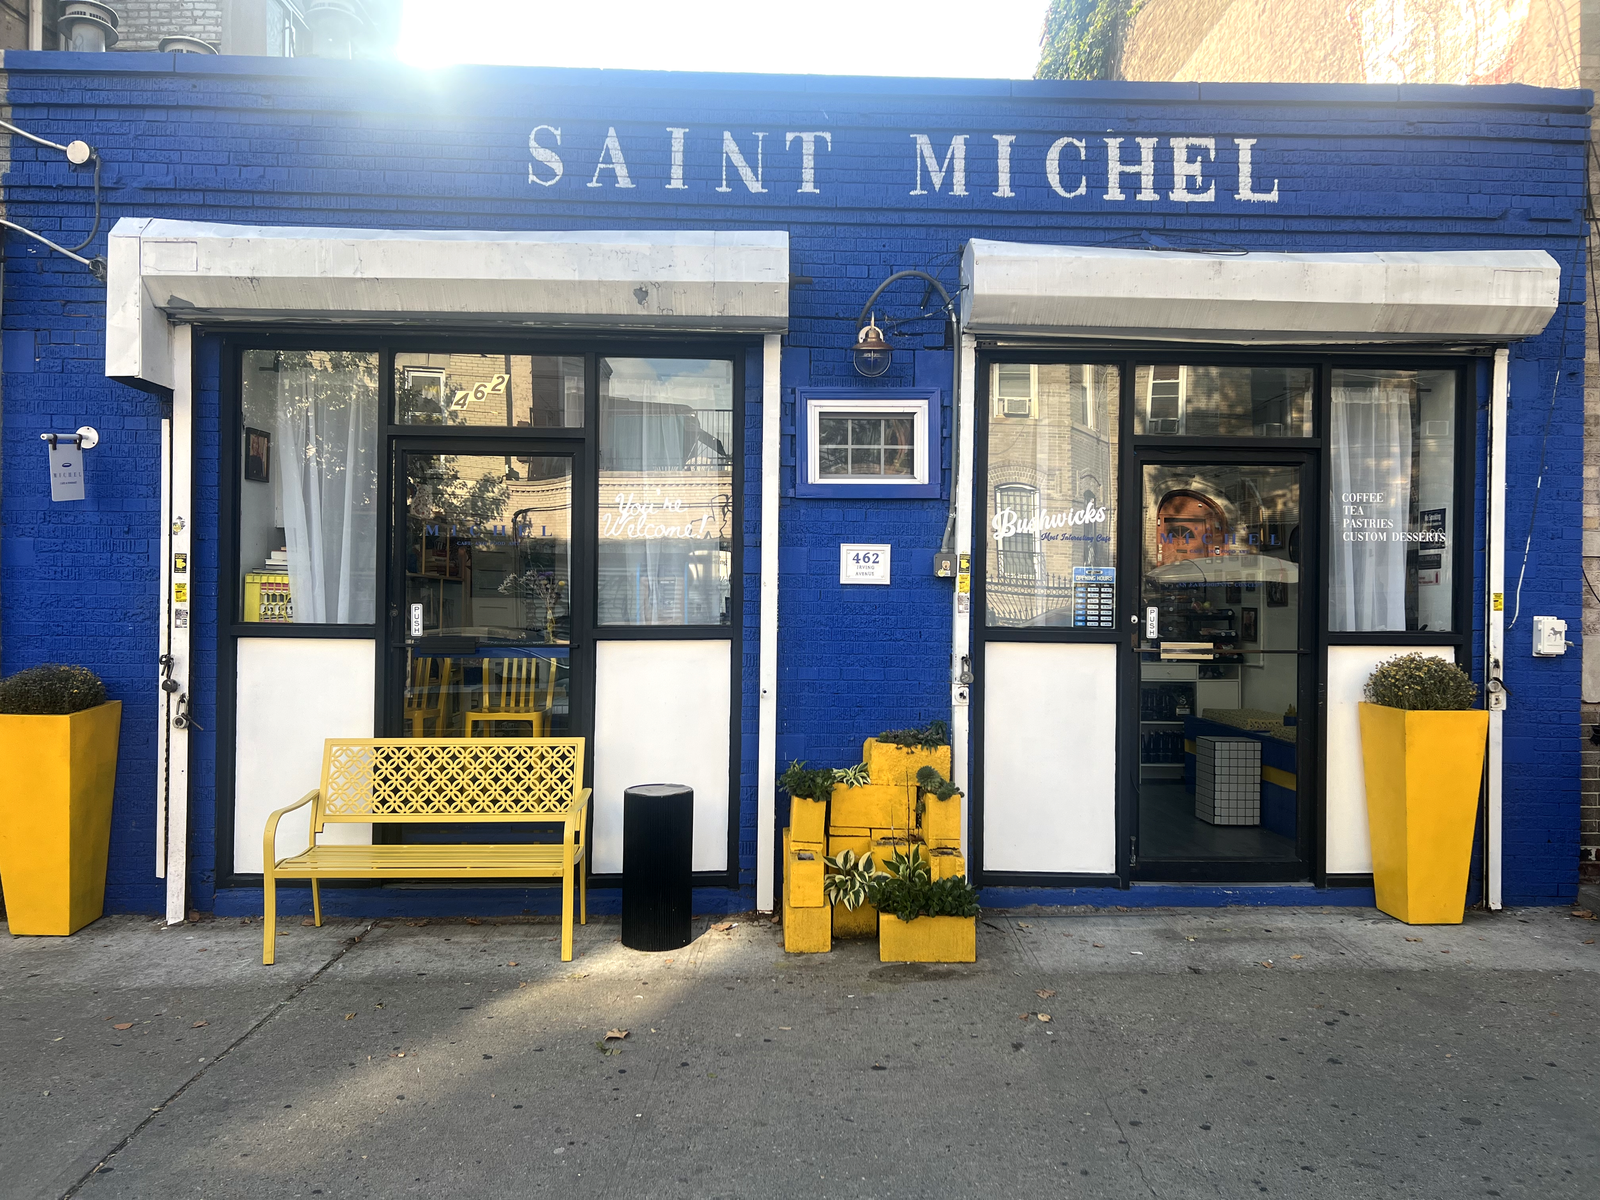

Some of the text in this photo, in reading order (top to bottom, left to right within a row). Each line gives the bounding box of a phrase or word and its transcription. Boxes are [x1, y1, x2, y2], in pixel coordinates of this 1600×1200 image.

[527, 125, 1280, 203] SAINT MICHEL
[453, 375, 506, 409] 462
[1341, 492, 1384, 503] COFFEE
[614, 488, 689, 524] You're
[1342, 505, 1365, 516] TEA
[602, 512, 708, 539] Welcome!
[991, 500, 1107, 540] Bushwicks
[1342, 518, 1394, 529] PASTRIES
[425, 524, 553, 537] MICHEL
[1342, 531, 1446, 542] CUSTOM DESSERTS
[1041, 532, 1058, 541] Most
[1060, 532, 1095, 543] Interesting
[1160, 533, 1281, 545] MICHEL
[852, 552, 880, 564] 462
